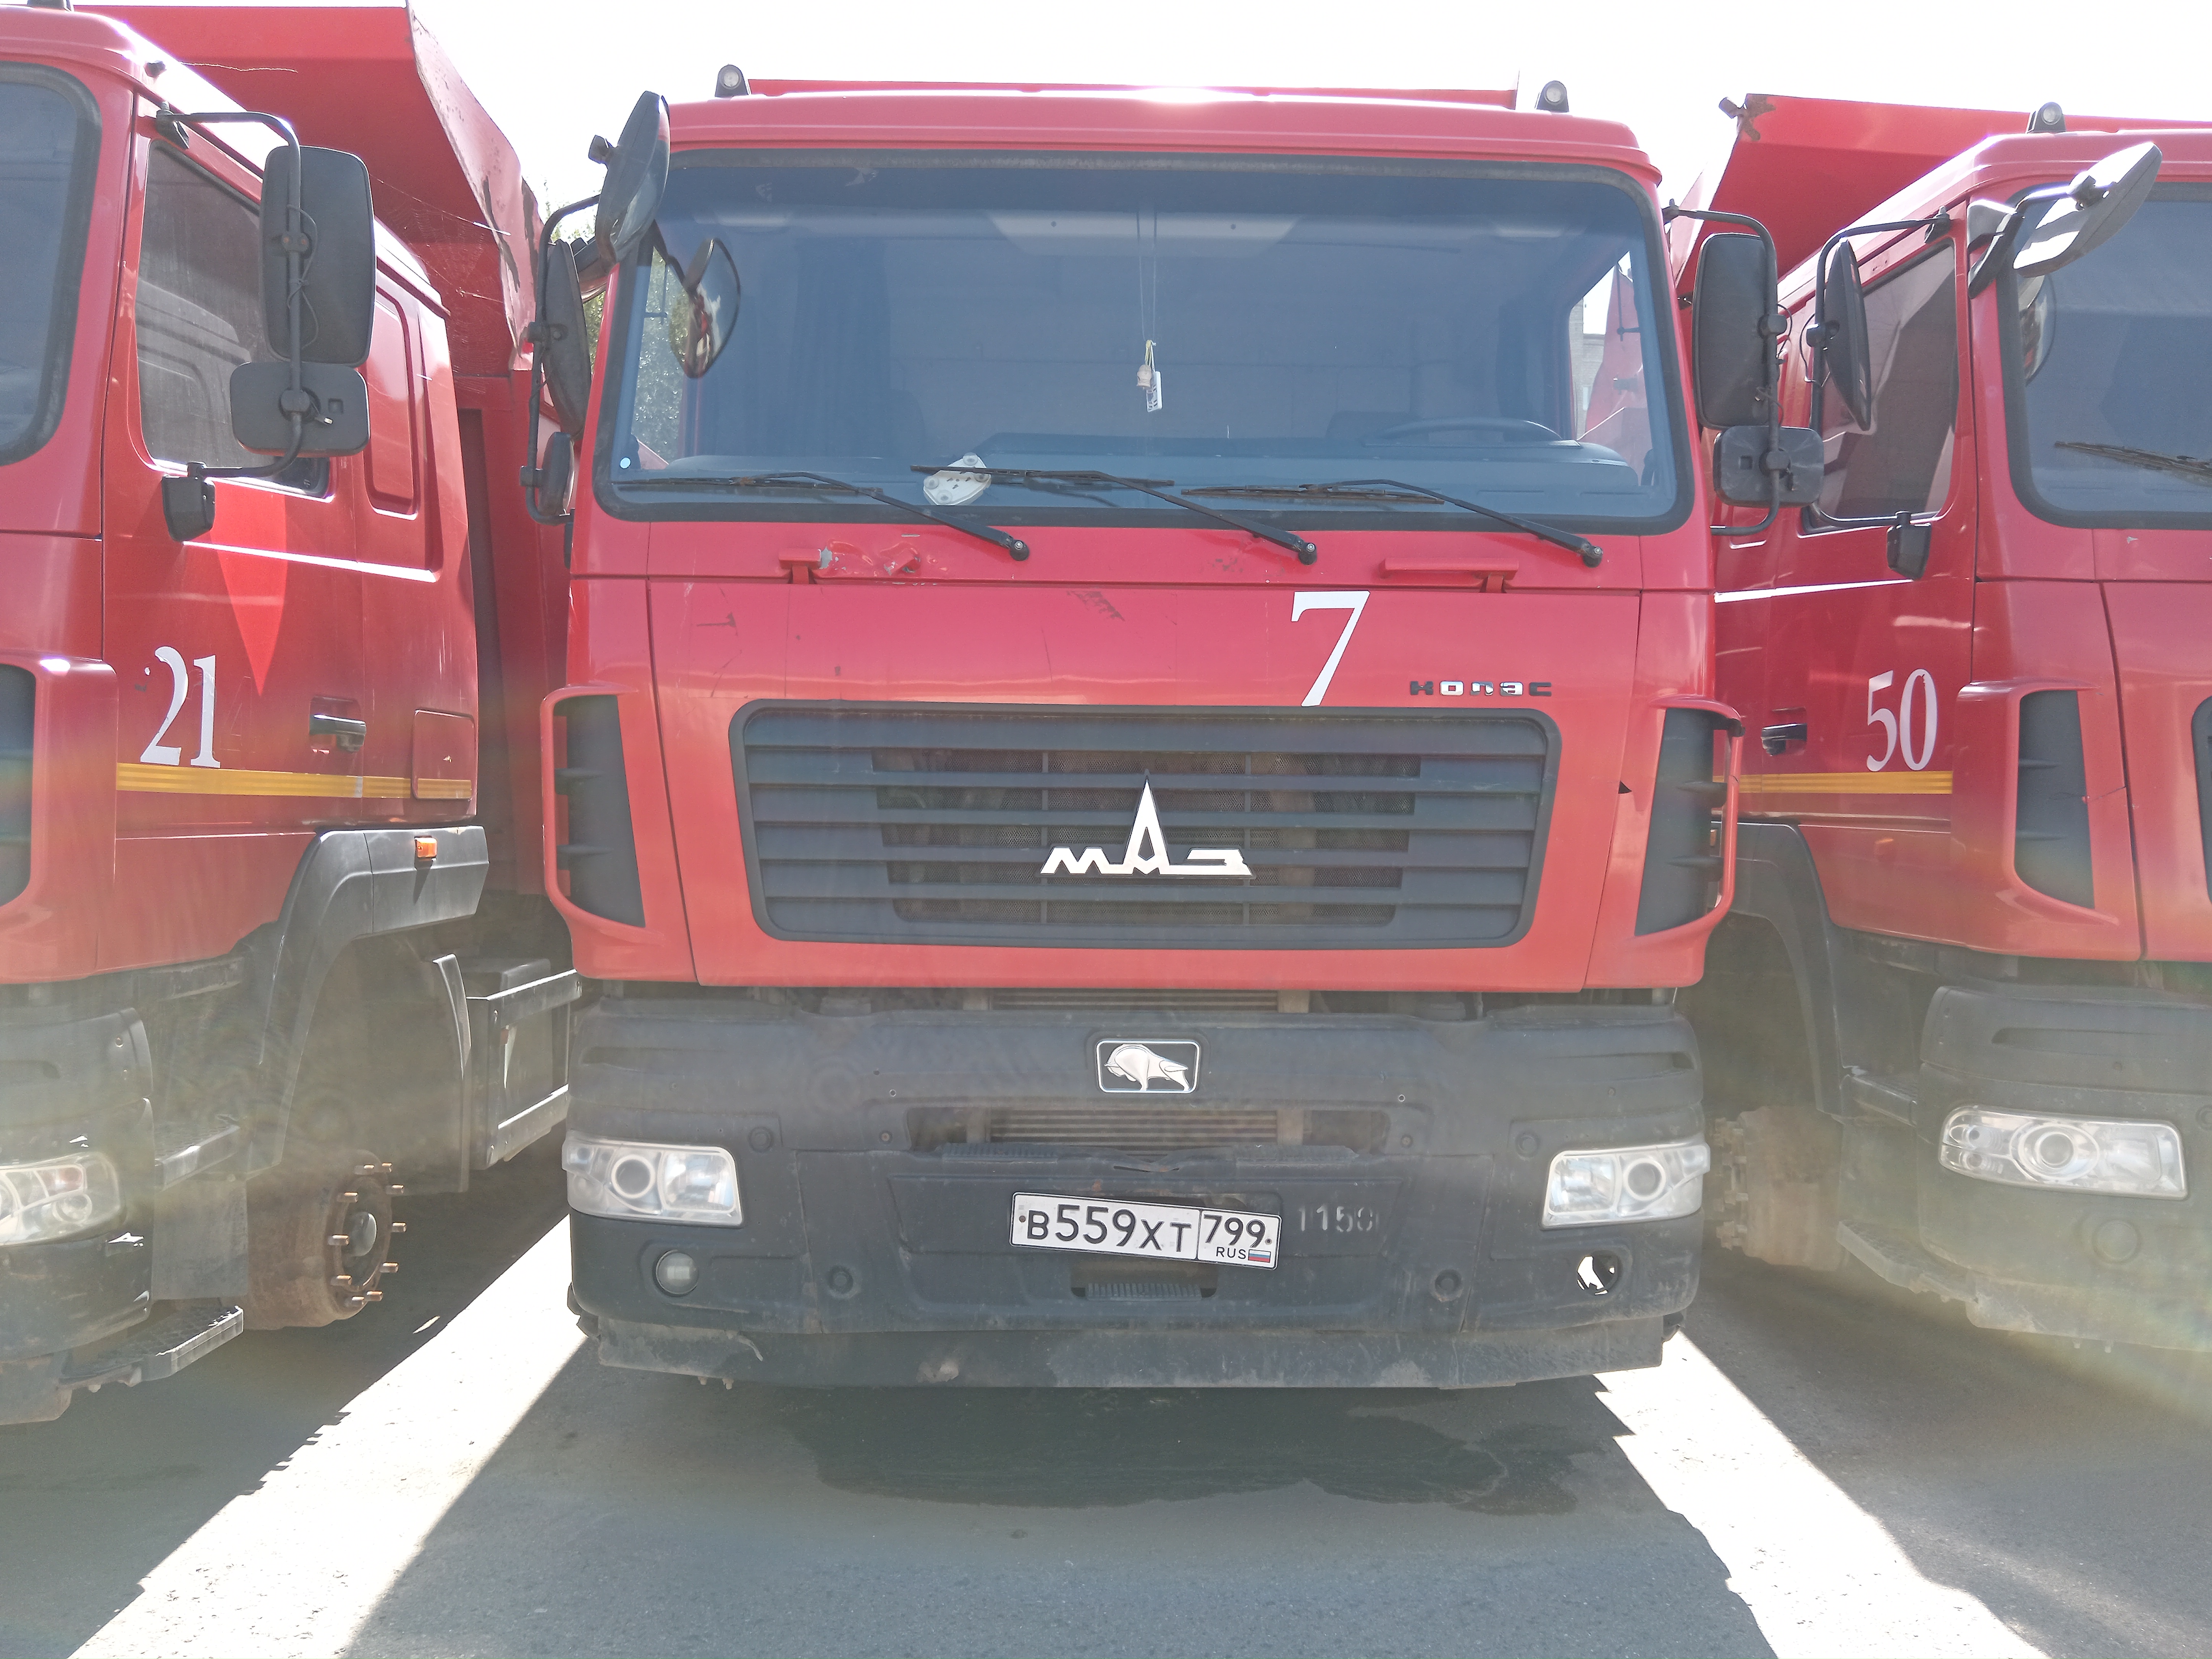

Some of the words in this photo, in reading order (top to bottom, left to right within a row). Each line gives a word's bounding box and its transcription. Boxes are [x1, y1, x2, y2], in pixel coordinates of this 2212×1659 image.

[1291, 590, 1370, 707] 7
[140, 645, 220, 768] 21
[1866, 668, 1938, 772] 50
[1203, 1214, 1266, 1248] 799
[1216, 1247, 1247, 1260] RUS
